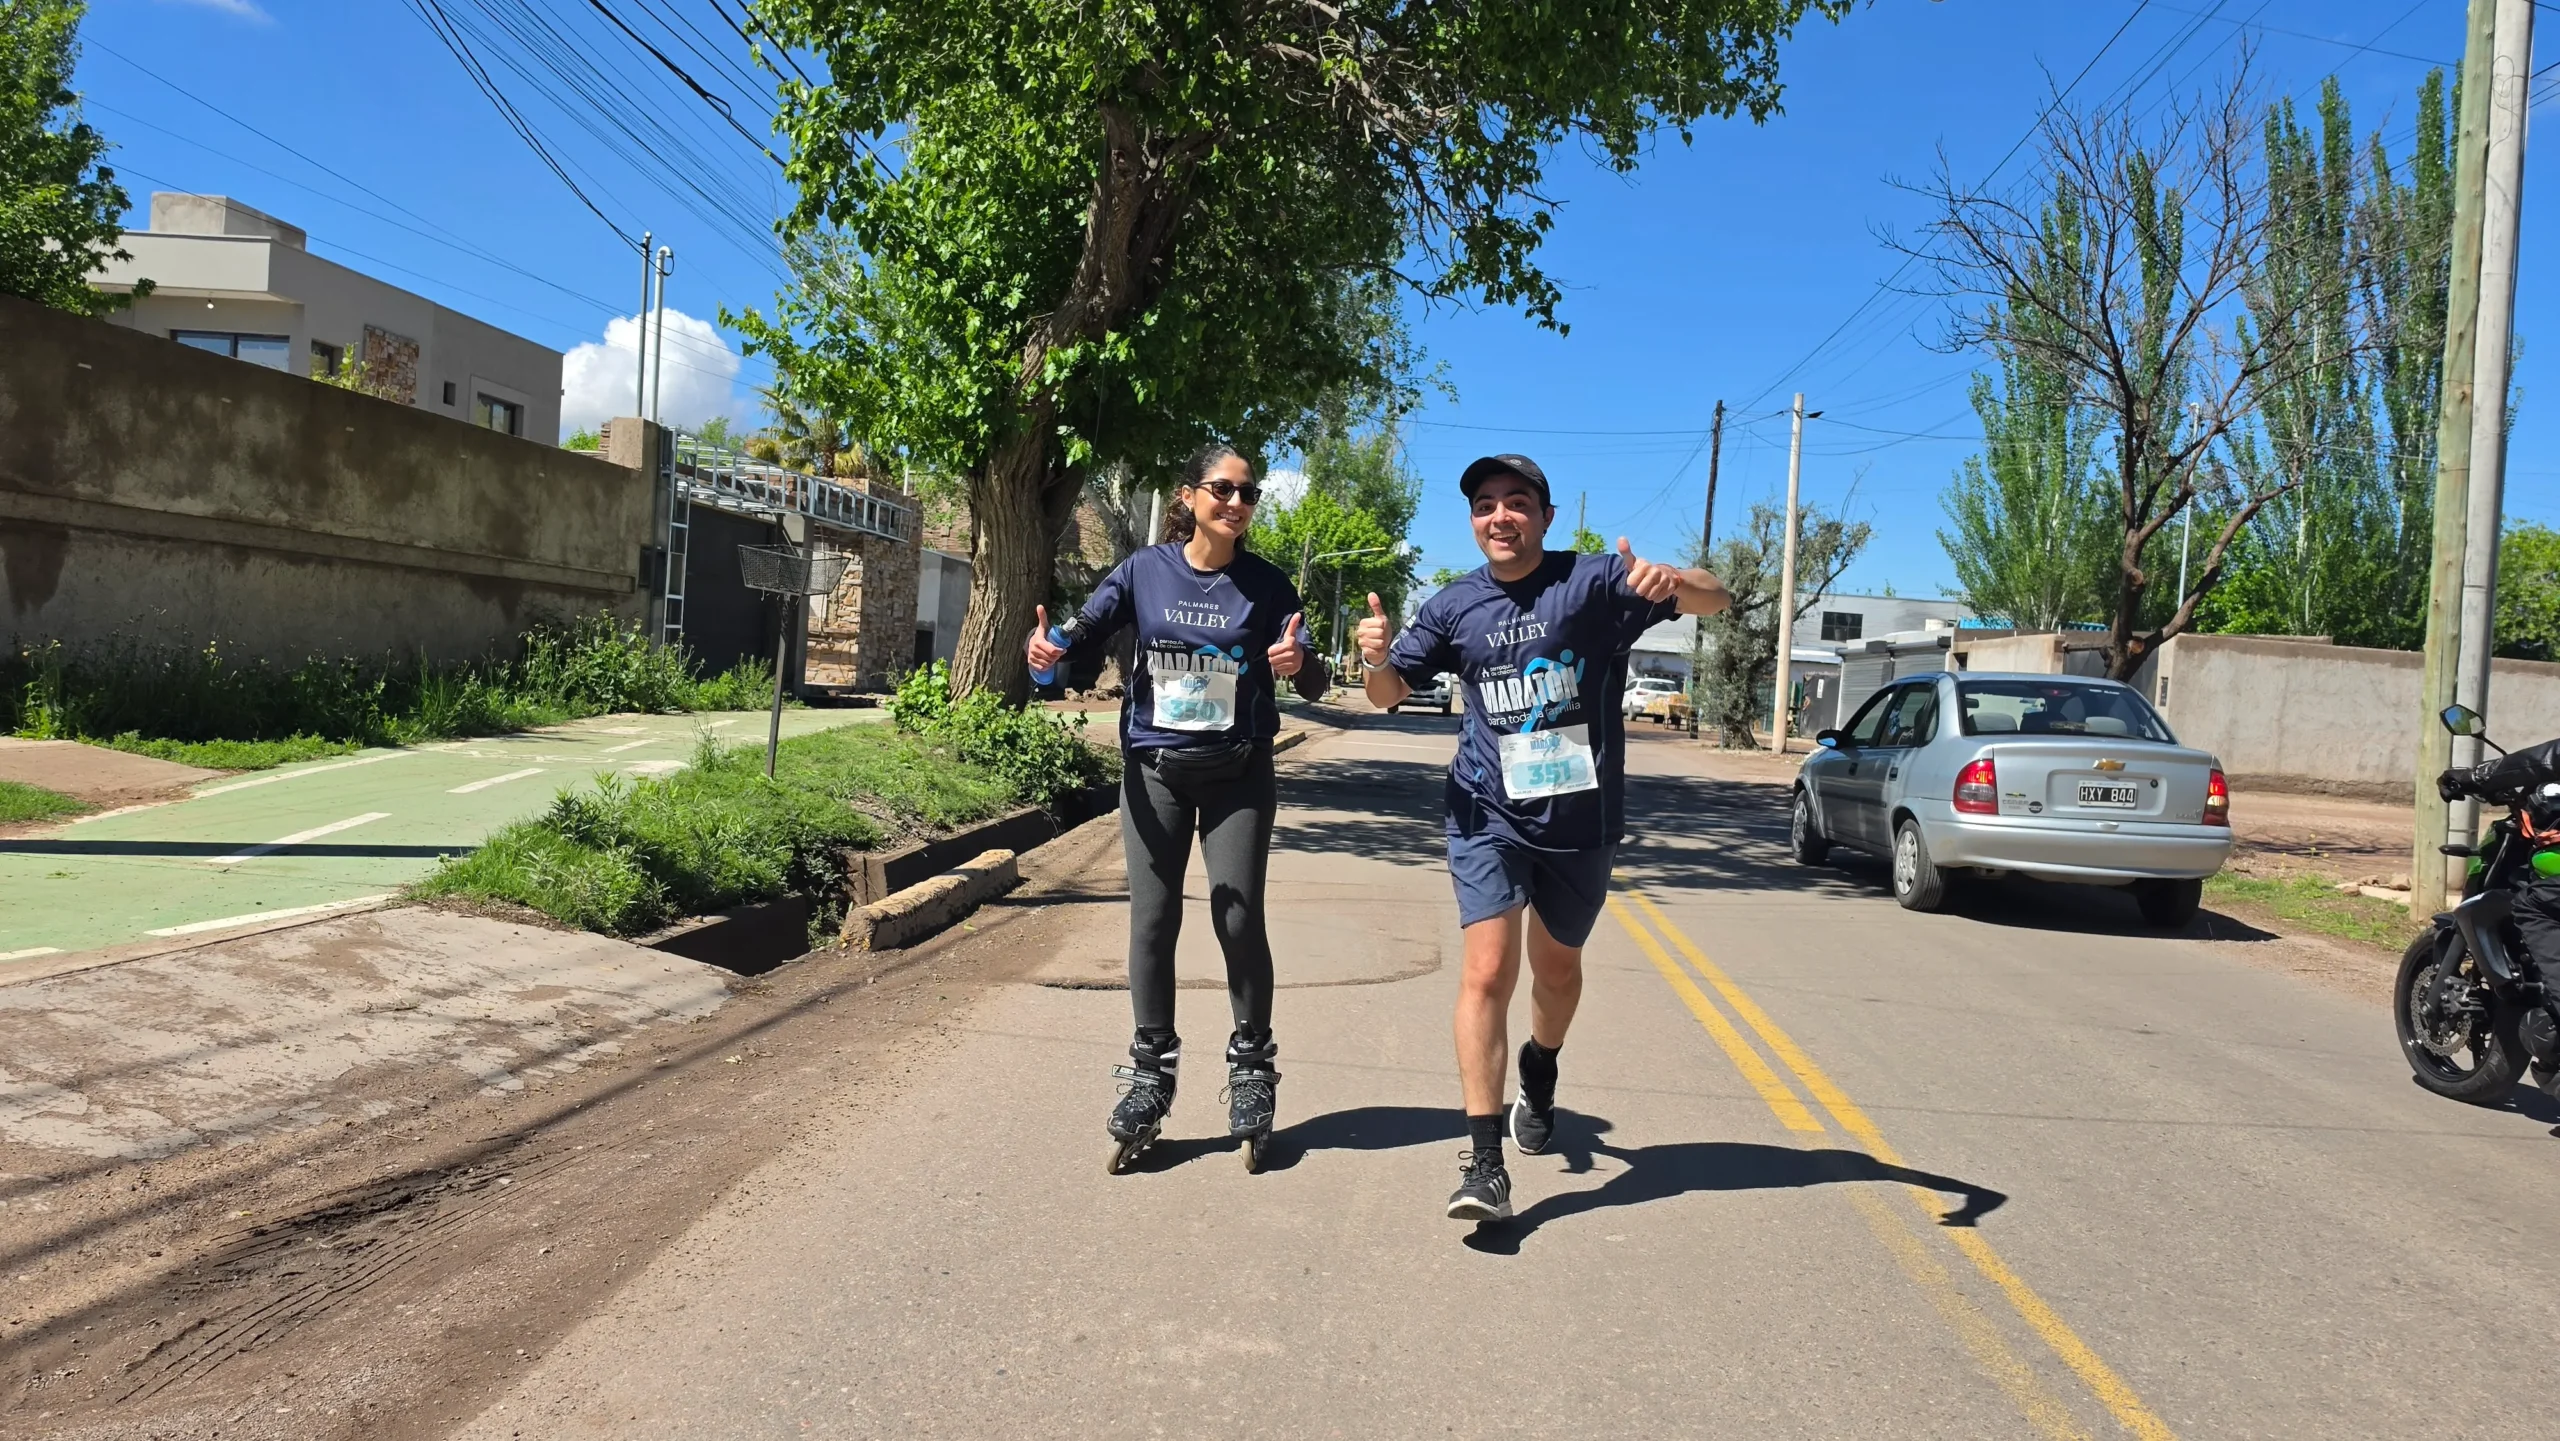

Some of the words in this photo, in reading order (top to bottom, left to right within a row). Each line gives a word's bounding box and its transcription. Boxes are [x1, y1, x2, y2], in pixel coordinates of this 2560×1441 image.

[1178, 600, 1220, 611] PALMARES
[1164, 608, 1231, 629] VALLEY
[1498, 613, 1536, 628] PALMARES
[1485, 621, 1549, 648] VALLEY
[1479, 662, 1579, 714] MARATÓN
[1169, 699, 1216, 721] 350
[1487, 715, 1507, 727] para
[1508, 711, 1533, 725] toda
[1534, 709, 1544, 719] la
[1545, 699, 1581, 717] familia
[1527, 759, 1571, 786] 351
[2080, 787, 2104, 801] HXY
[2111, 788, 2134, 802] 844
